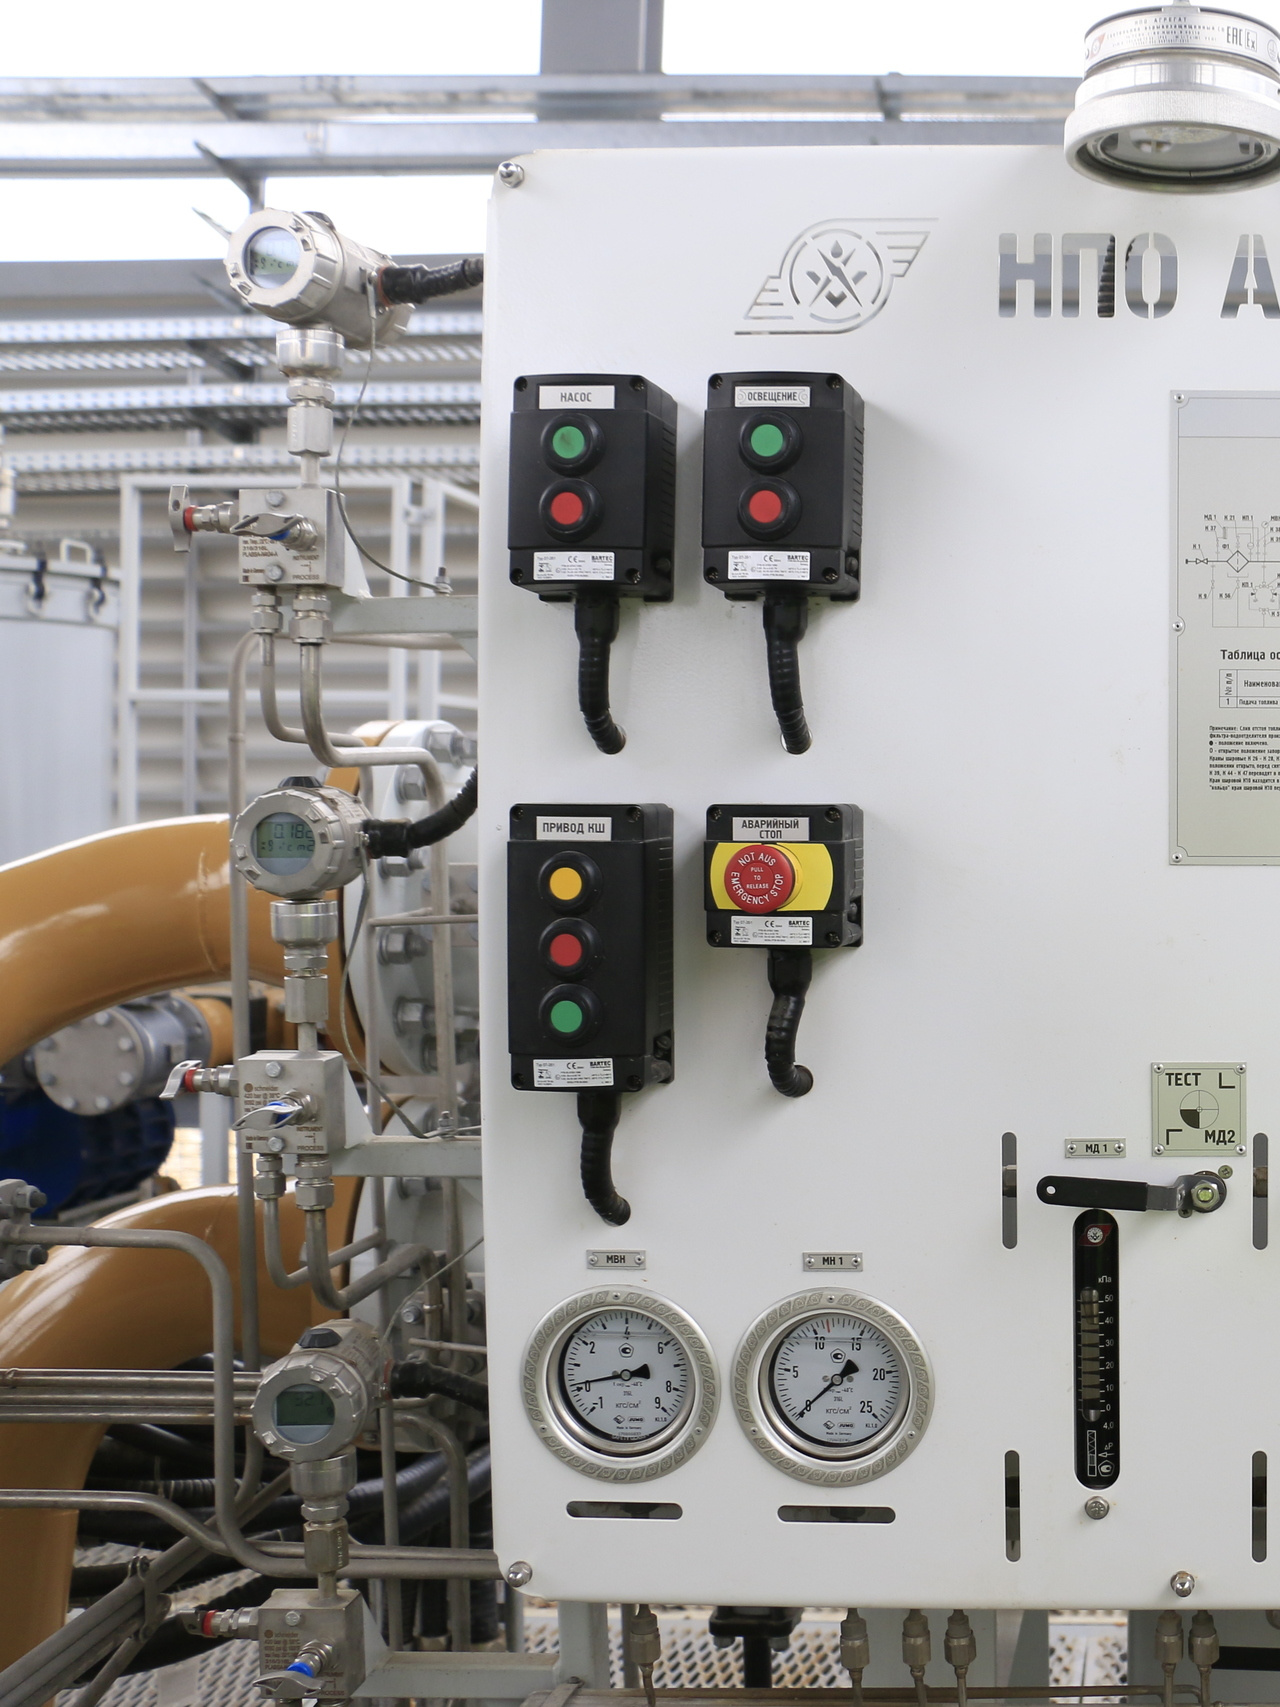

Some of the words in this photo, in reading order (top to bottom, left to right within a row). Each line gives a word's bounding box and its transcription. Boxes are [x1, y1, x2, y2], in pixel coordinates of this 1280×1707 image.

[998, 232, 1180, 319] НПО
[559, 391, 592, 403] НАСОС
[747, 391, 798, 404] ОСВЕЩЕНИЕ
[1220, 649, 1265, 661] Таблица
[542, 822, 584, 834] ПРИВОД
[587, 821, 606, 834] КШ
[741, 818, 799, 830] АВАРИЙНЫЙ
[759, 830, 783, 840] СТОП
[737, 851, 755, 867] NOT
[758, 852, 776, 866] AUS
[731, 871, 770, 905] EMERGENCY
[770, 873, 784, 897] STOP
[1165, 1073, 1202, 1087] ТЕСТ
[1204, 1129, 1236, 1145] МД2
[1085, 1142, 1100, 1155] МД
[1103, 1143, 1108, 1154] 1
[606, 1255, 625, 1263] МВН
[822, 1257, 835, 1265] МН
[839, 1257, 843, 1265] 1
[1098, 1275, 1112, 1283] кПа
[589, 1341, 596, 1354] 2
[657, 1341, 664, 1354] 6
[814, 1336, 825, 1350] 10
[851, 1337, 862, 1351] 15
[1105, 1339, 1114, 1347] 30
[1105, 1361, 1114, 1369] 20
[792, 1366, 799, 1378] 5
[872, 1368, 886, 1381] 20
[665, 1380, 672, 1393] 8
[1105, 1384, 1114, 1392] 10
[592, 1396, 603, 1409] -1
[655, 1396, 661, 1409] 9
[860, 1401, 873, 1413] 25
